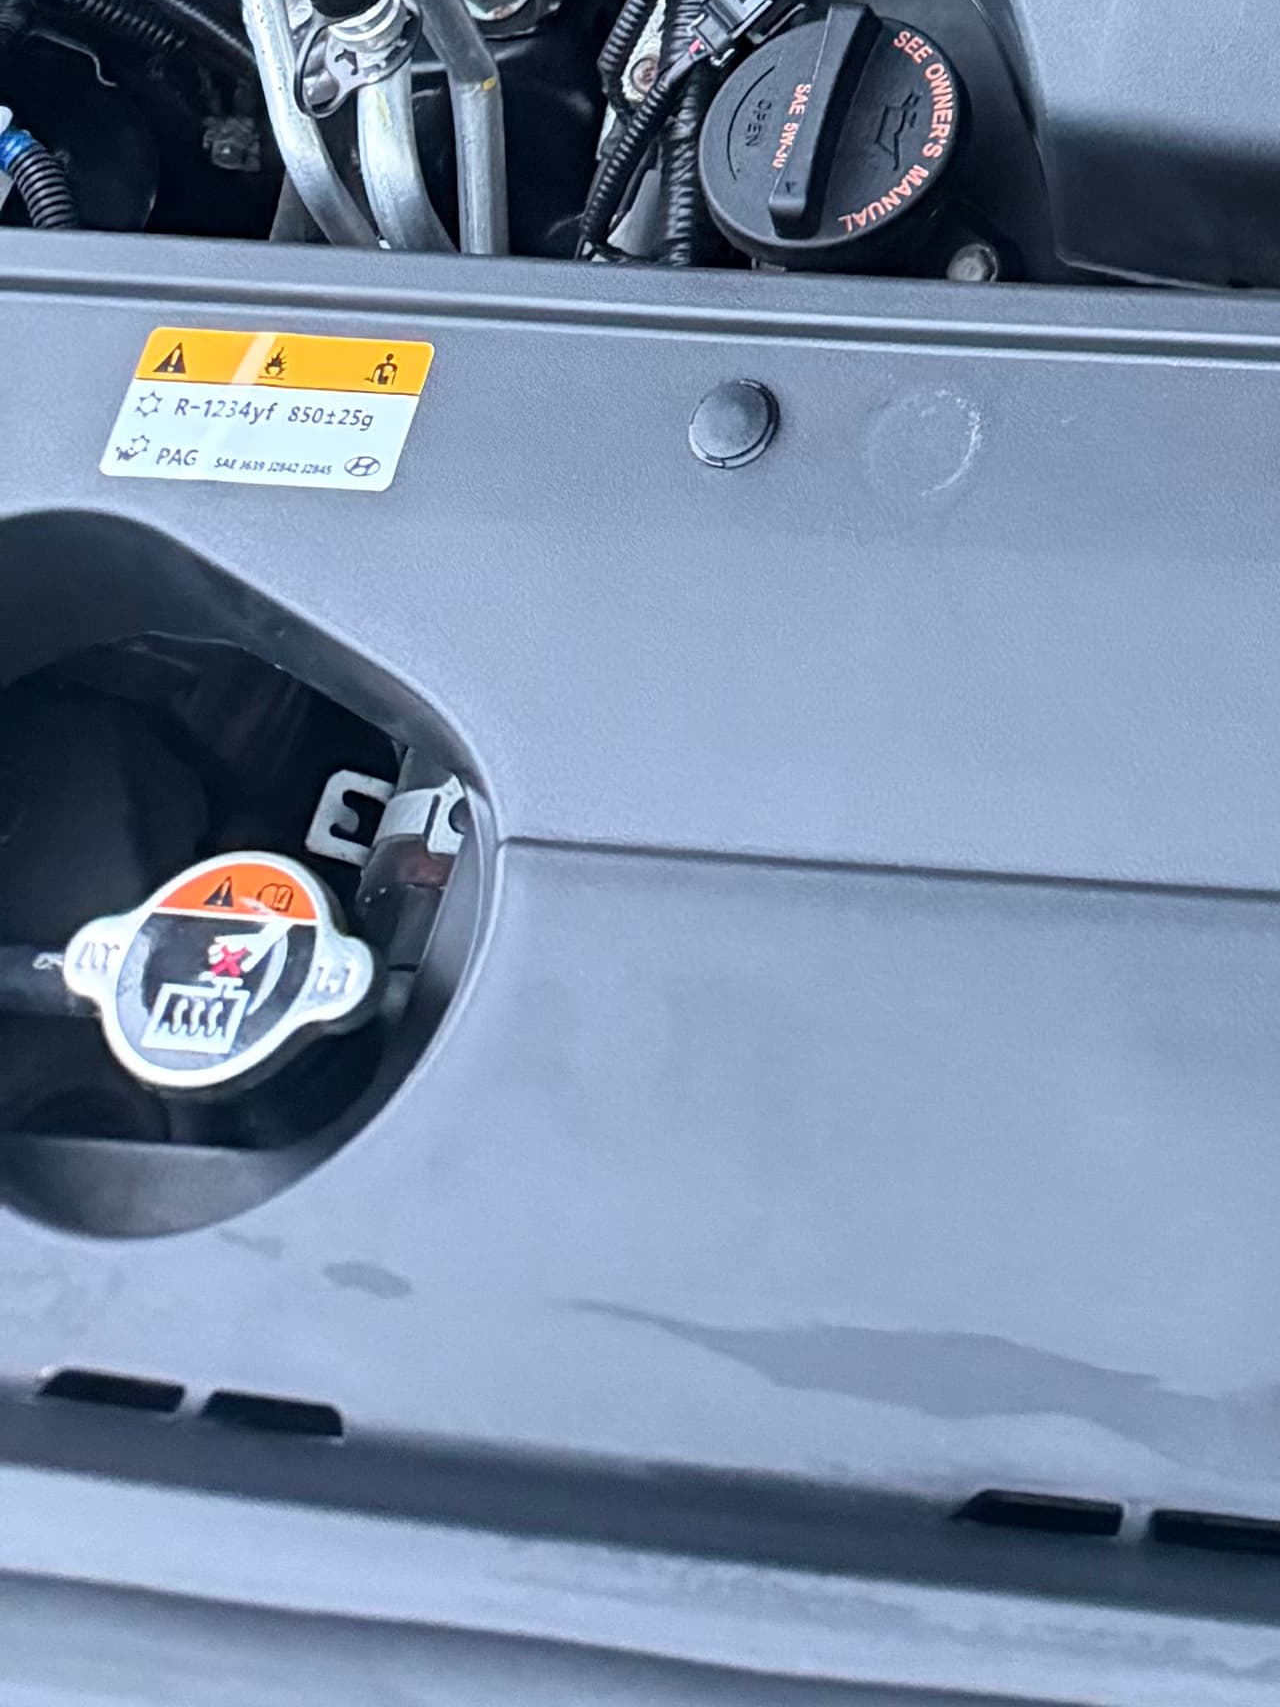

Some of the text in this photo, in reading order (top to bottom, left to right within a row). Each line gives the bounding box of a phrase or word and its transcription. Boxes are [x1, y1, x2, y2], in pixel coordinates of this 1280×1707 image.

[788, 83, 813, 115] SAE
[838, 29, 954, 232] SEE OWNER'S MANUAL
[173, 397, 375, 432] R-1234yf 850±25g
[155, 448, 199, 468] PAG
[213, 456, 238, 470] SAE
